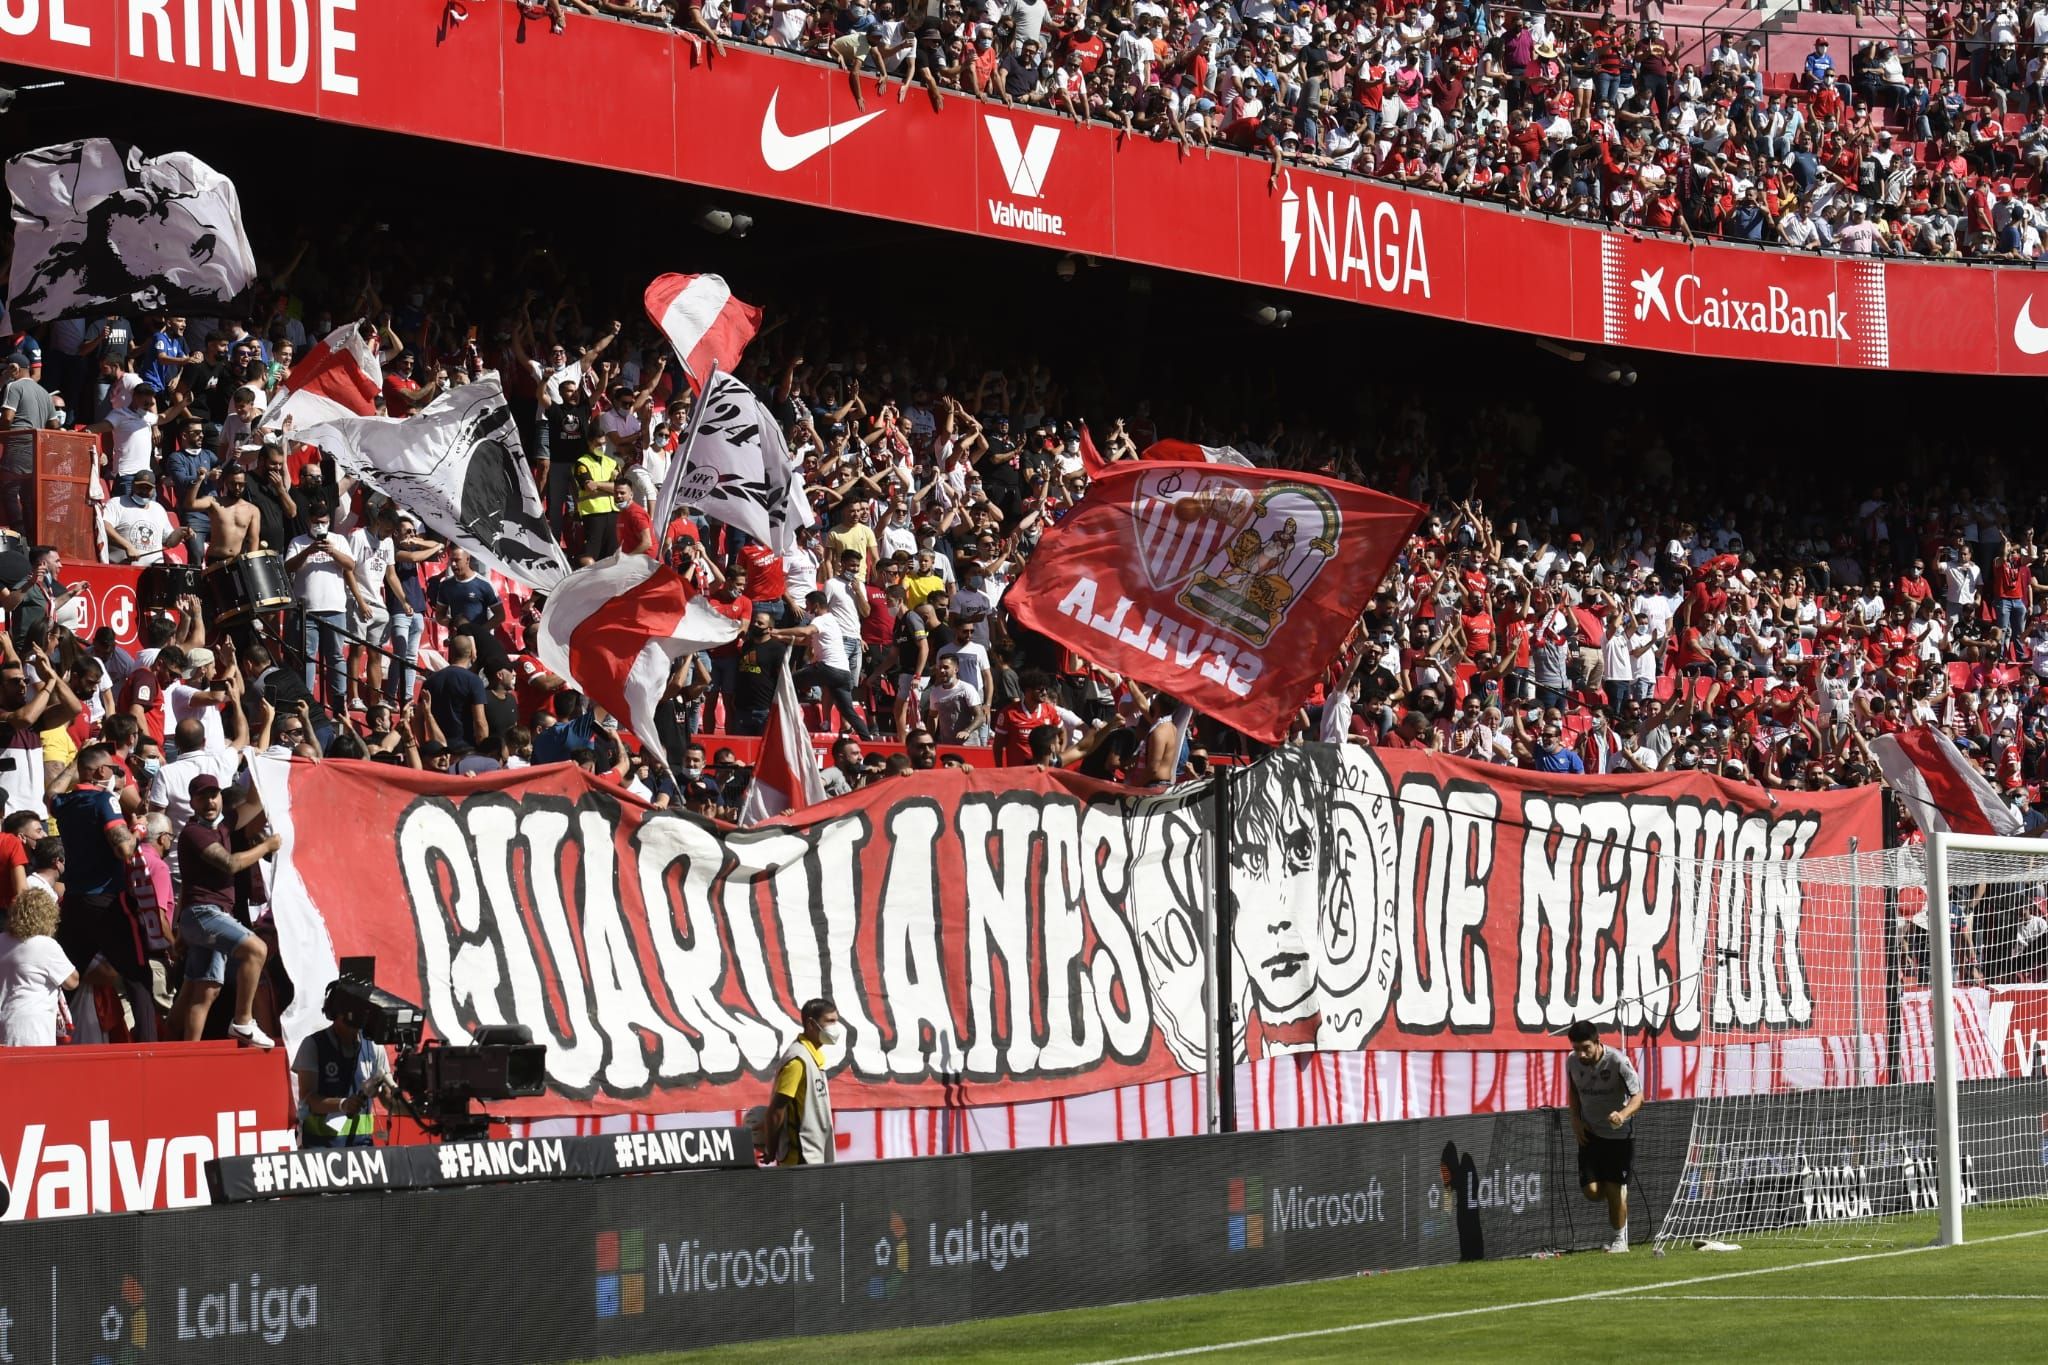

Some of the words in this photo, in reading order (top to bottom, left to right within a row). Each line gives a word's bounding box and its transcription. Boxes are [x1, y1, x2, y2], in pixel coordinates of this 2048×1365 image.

[129, 0, 359, 96] RINDE
[988, 199, 1063, 236] Valvoline
[1306, 186, 1431, 299] NAGA
[1674, 274, 1852, 341] CaixaBank
[1395, 772, 1502, 1034] DE
[252, 1149, 388, 1193] #FANCAM
[439, 1138, 567, 1179] #FANCAM
[614, 1129, 735, 1168] #FANCAM
[1272, 1175, 1385, 1232] Microsoft
[1467, 1163, 1542, 1213] LaLiga
[657, 1229, 815, 1294] Microsoft
[928, 1210, 1030, 1271] LaLiga
[177, 1273, 318, 1345] LaLiga
